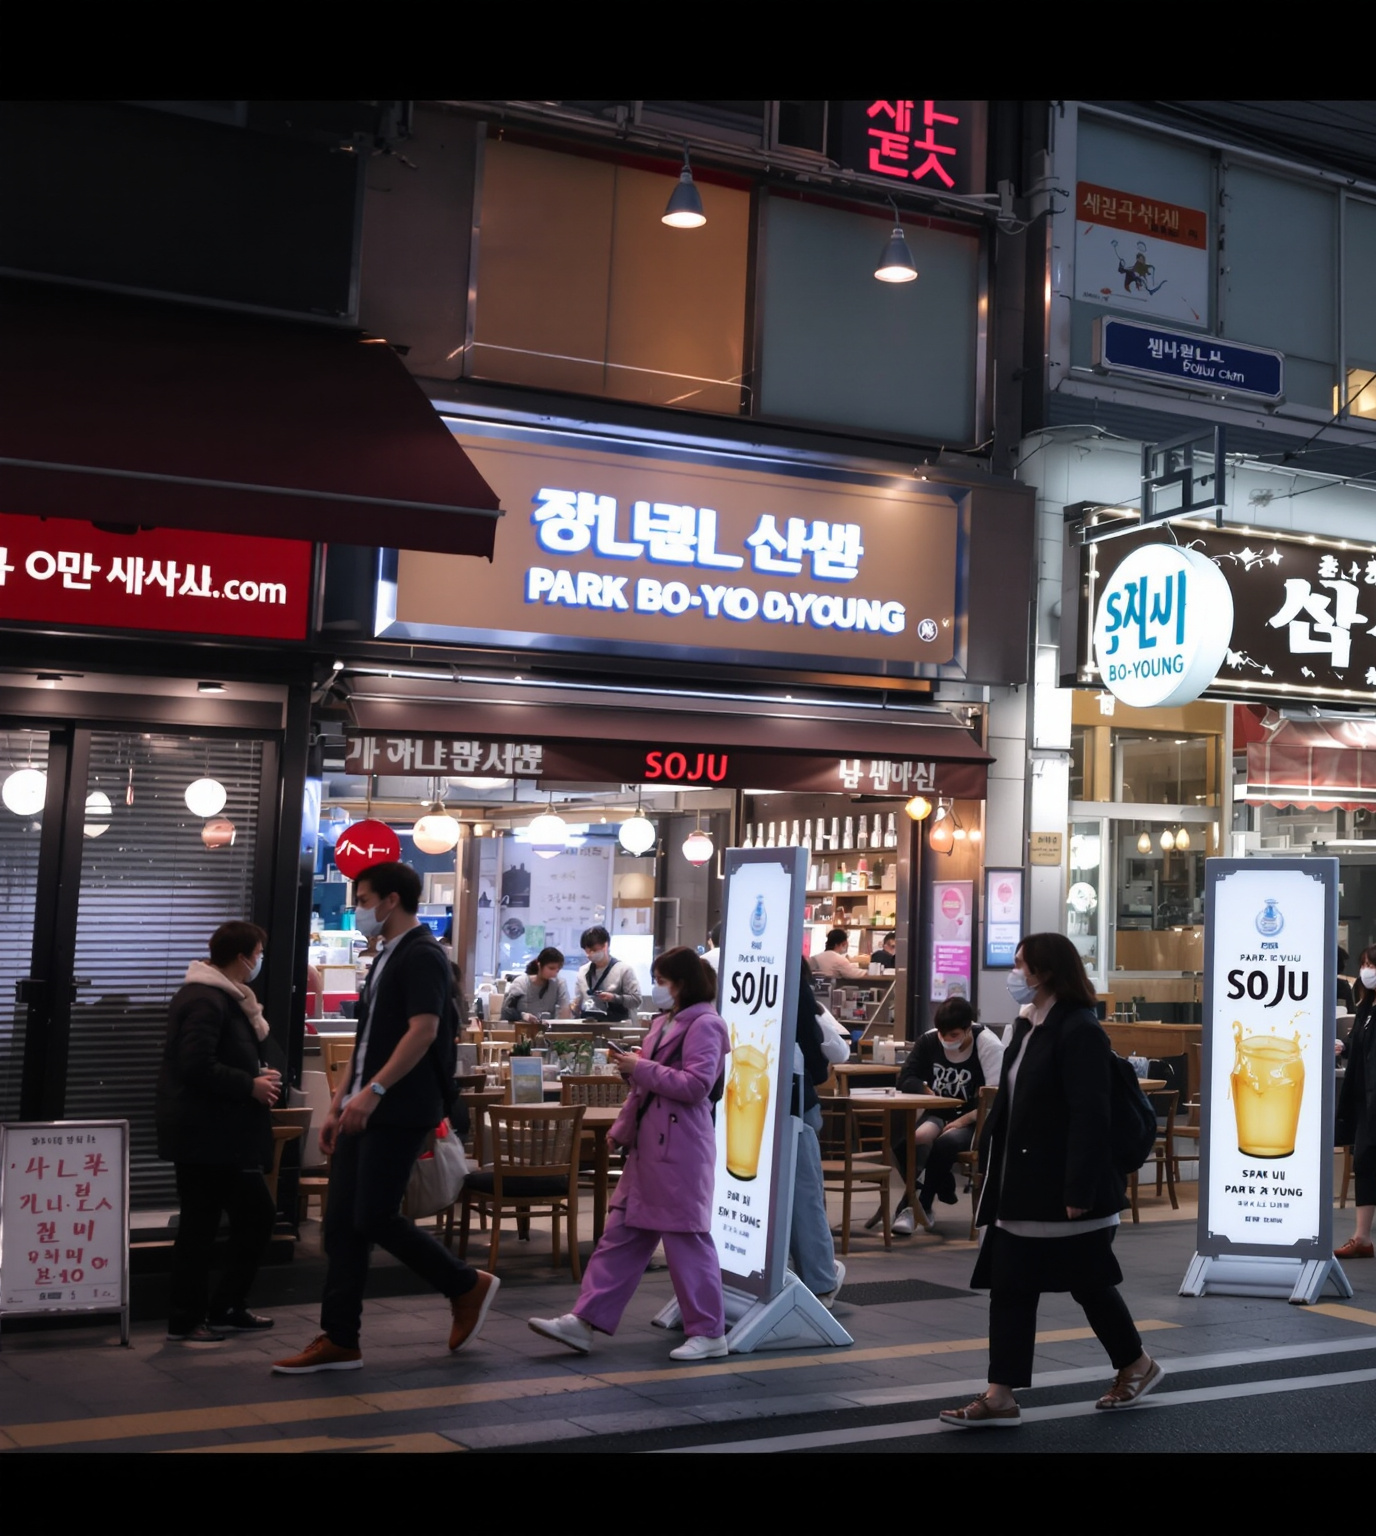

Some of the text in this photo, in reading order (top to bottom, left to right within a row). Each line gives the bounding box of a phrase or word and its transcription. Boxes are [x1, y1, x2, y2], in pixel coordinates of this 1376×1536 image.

[526, 566, 629, 611] PARK
[1108, 654, 1185, 682] BO-YOUNG
[645, 751, 729, 782] SOJU
[730, 966, 779, 1016] SOJU
[1226, 964, 1309, 1009] SOJU
